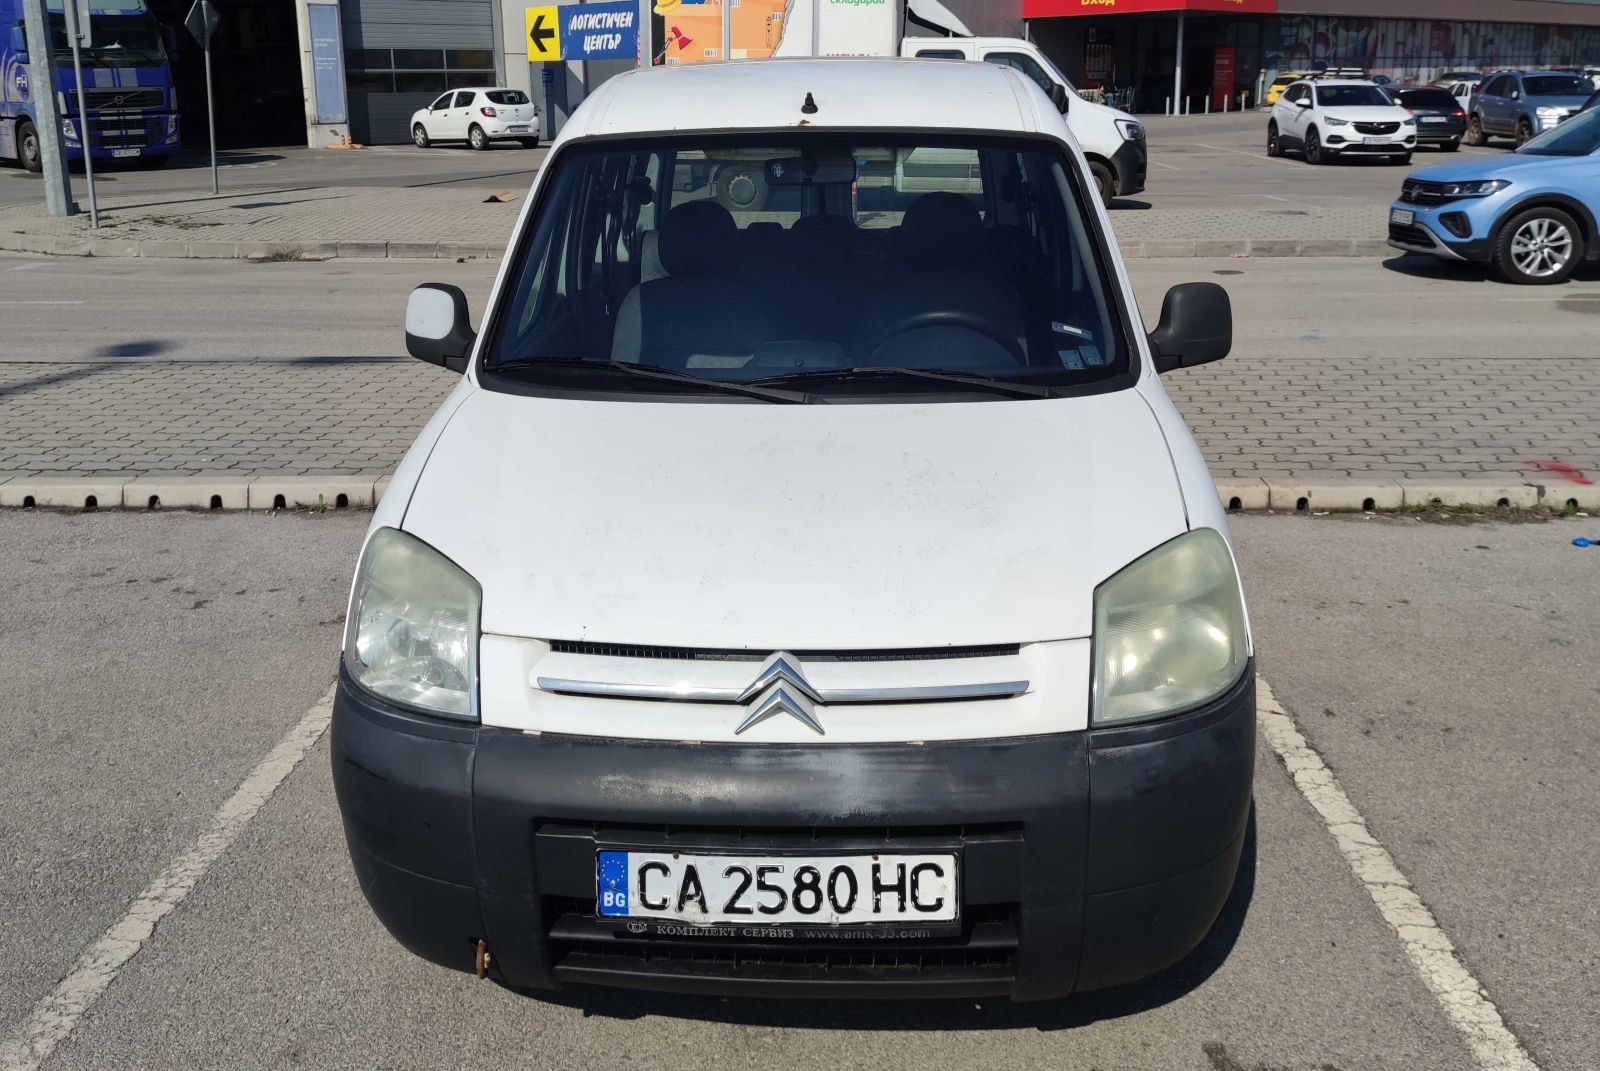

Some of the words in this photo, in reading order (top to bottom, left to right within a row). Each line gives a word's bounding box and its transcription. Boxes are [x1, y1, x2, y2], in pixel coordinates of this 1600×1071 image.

[570, 11, 634, 31] ЛОГИСТИЧЕН
[583, 33, 622, 54] ЦЕНТЪР
[637, 860, 709, 914] CA
[722, 863, 858, 915] 2580
[603, 891, 626, 908] BG
[656, 925, 737, 937] КОМПЛЕКТ
[742, 928, 794, 938] СЕРВИЗ
